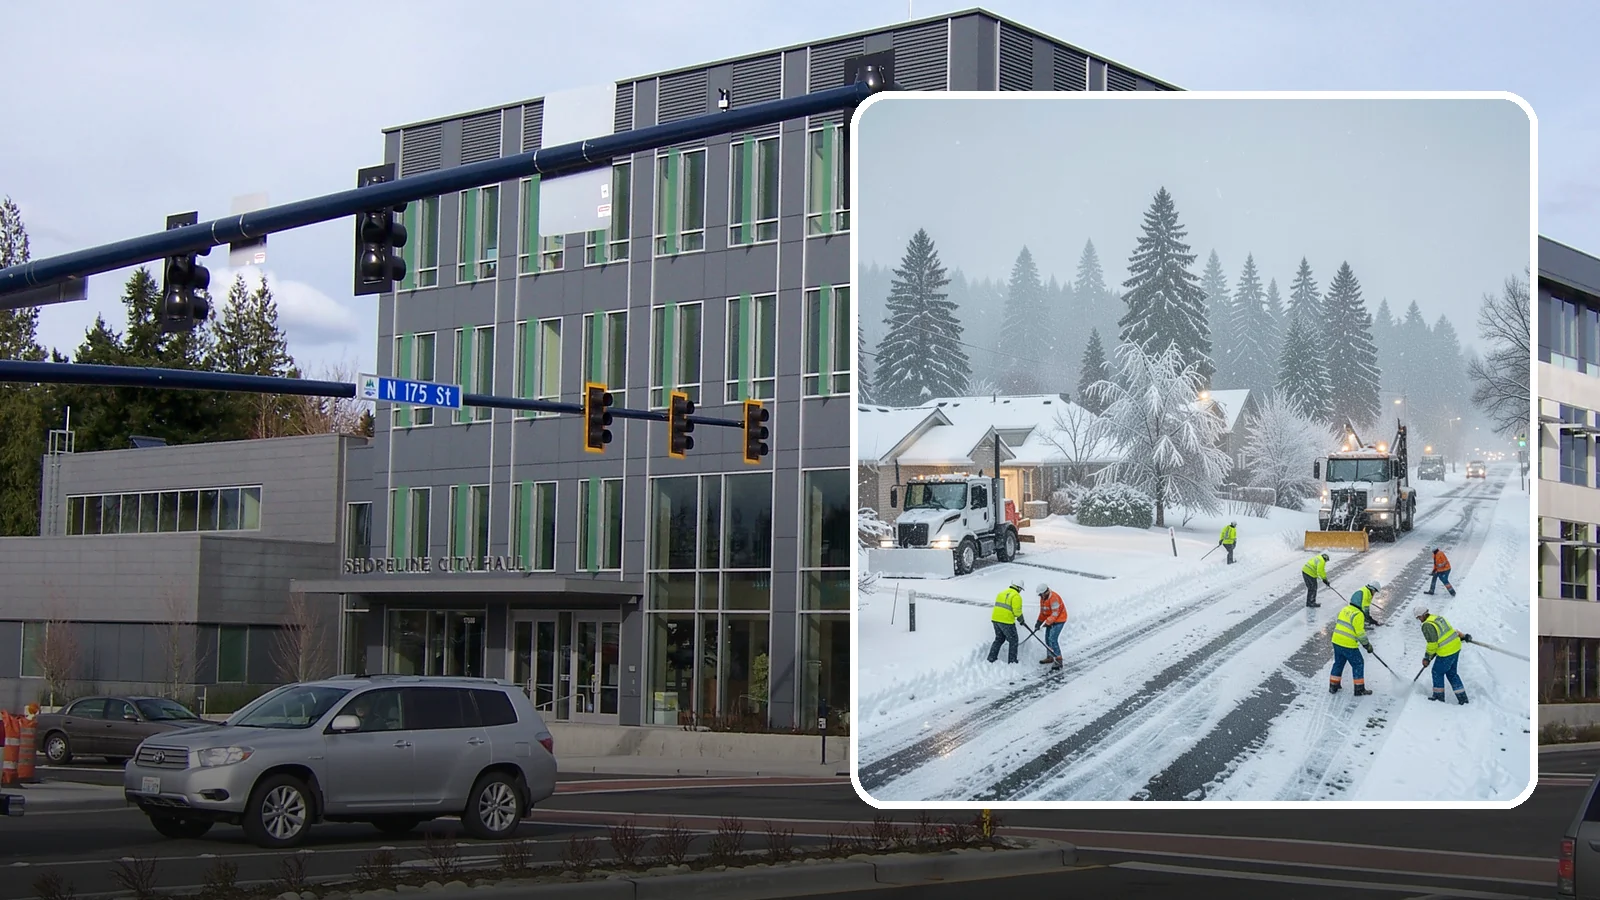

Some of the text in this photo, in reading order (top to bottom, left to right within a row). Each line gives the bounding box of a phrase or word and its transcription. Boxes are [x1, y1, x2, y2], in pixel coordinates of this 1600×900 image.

[387, 380, 451, 406] N 175 St
[344, 555, 525, 574] SHORELINE CITY HALL
